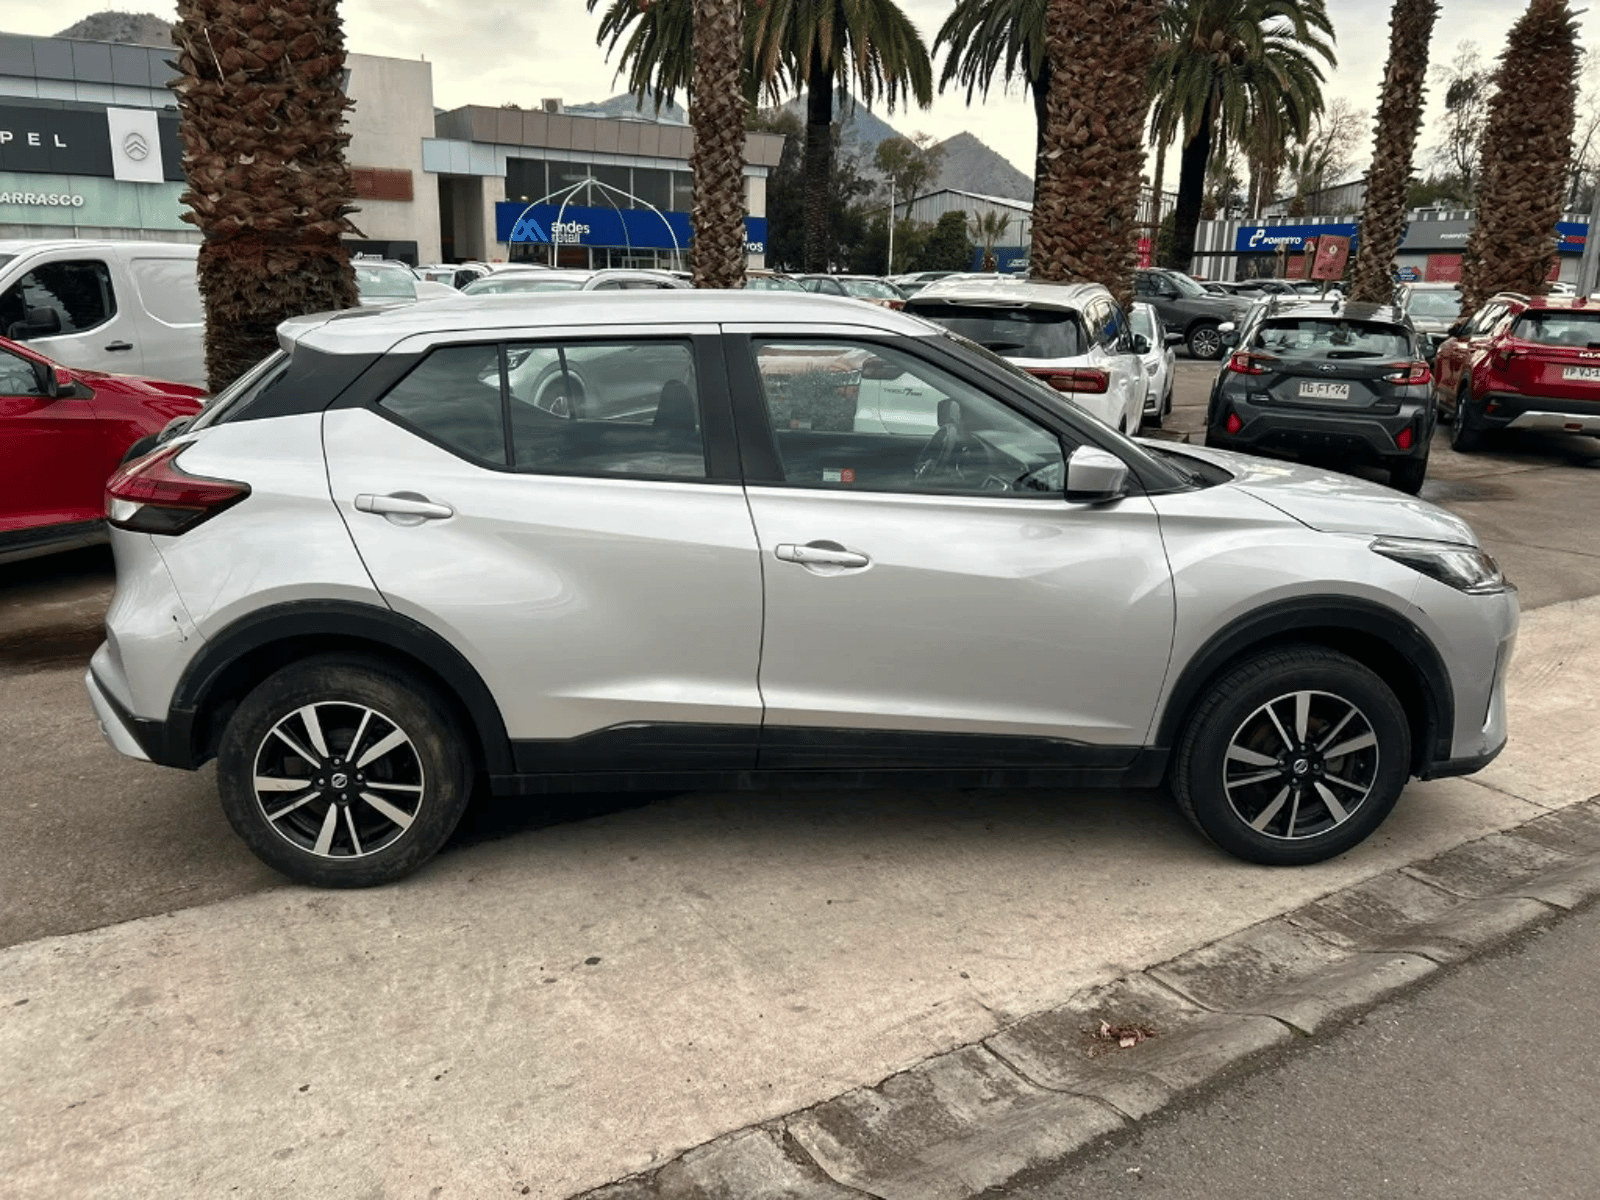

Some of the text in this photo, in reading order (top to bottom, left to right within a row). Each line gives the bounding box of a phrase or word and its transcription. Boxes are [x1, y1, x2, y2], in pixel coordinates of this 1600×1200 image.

[0, 130, 67, 147] PEL
[0, 192, 84, 206] ARRASCO
[551, 220, 590, 233] andes
